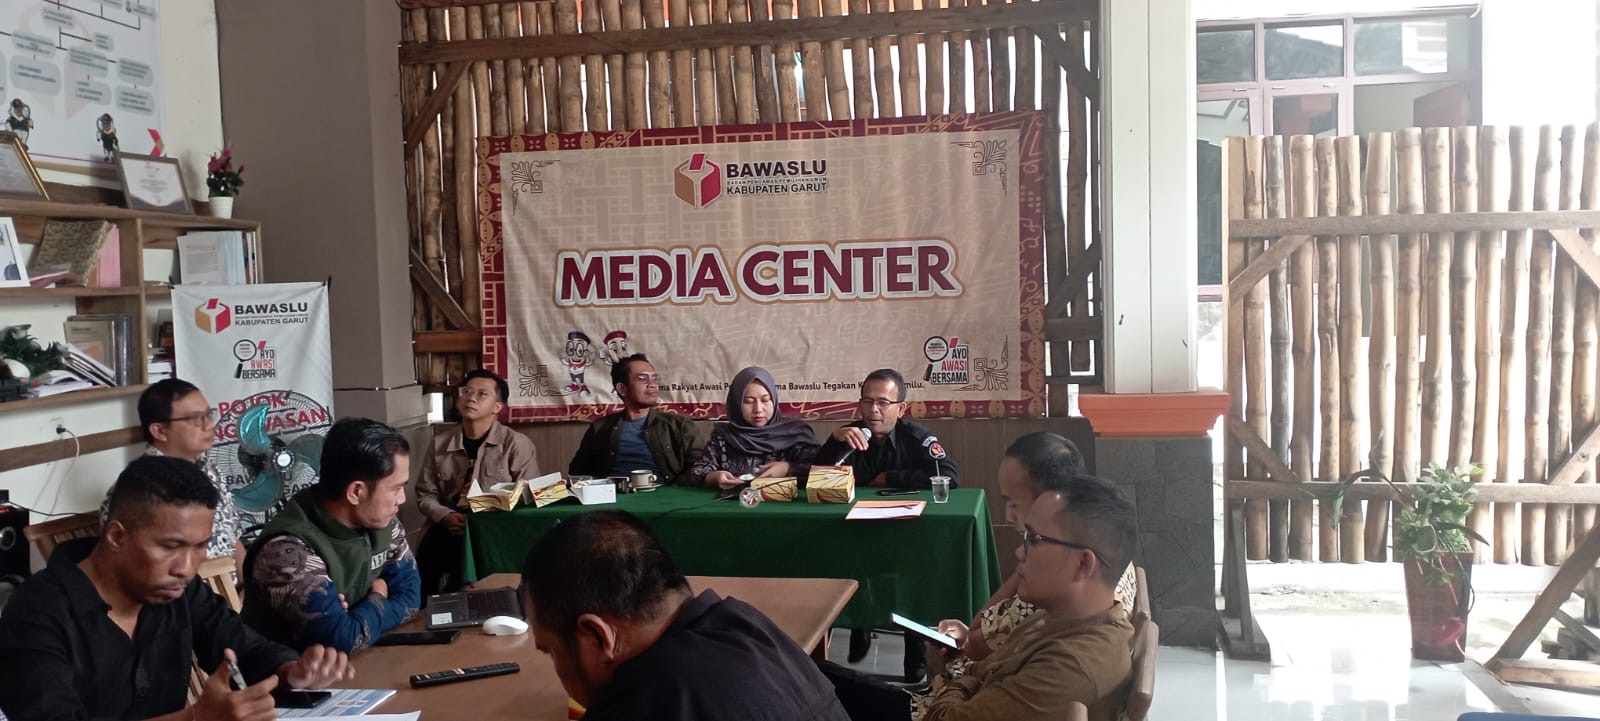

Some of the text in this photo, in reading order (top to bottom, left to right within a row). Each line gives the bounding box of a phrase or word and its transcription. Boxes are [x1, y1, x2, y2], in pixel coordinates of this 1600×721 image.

[726, 160, 827, 178] BAWASLU
[726, 183, 827, 195] KABUPATEN GARUT
[560, 245, 957, 301] MEDIA CENTER
[234, 302, 308, 314] BAWASLU
[234, 318, 281, 326] KABUPATEN
[259, 349, 275, 359] AYO
[951, 348, 967, 359] AYO
[251, 359, 275, 369] AWASI
[941, 360, 967, 371] AWASI
[242, 369, 276, 379] BERSAMA
[932, 371, 967, 383] BERSAMA
[671, 383, 698, 393] Rakyat
[700, 382, 722, 391] Awasi
[788, 382, 821, 390] Bawaslu
[823, 381, 856, 391] Tegakan
[905, 381, 924, 389] milu.
